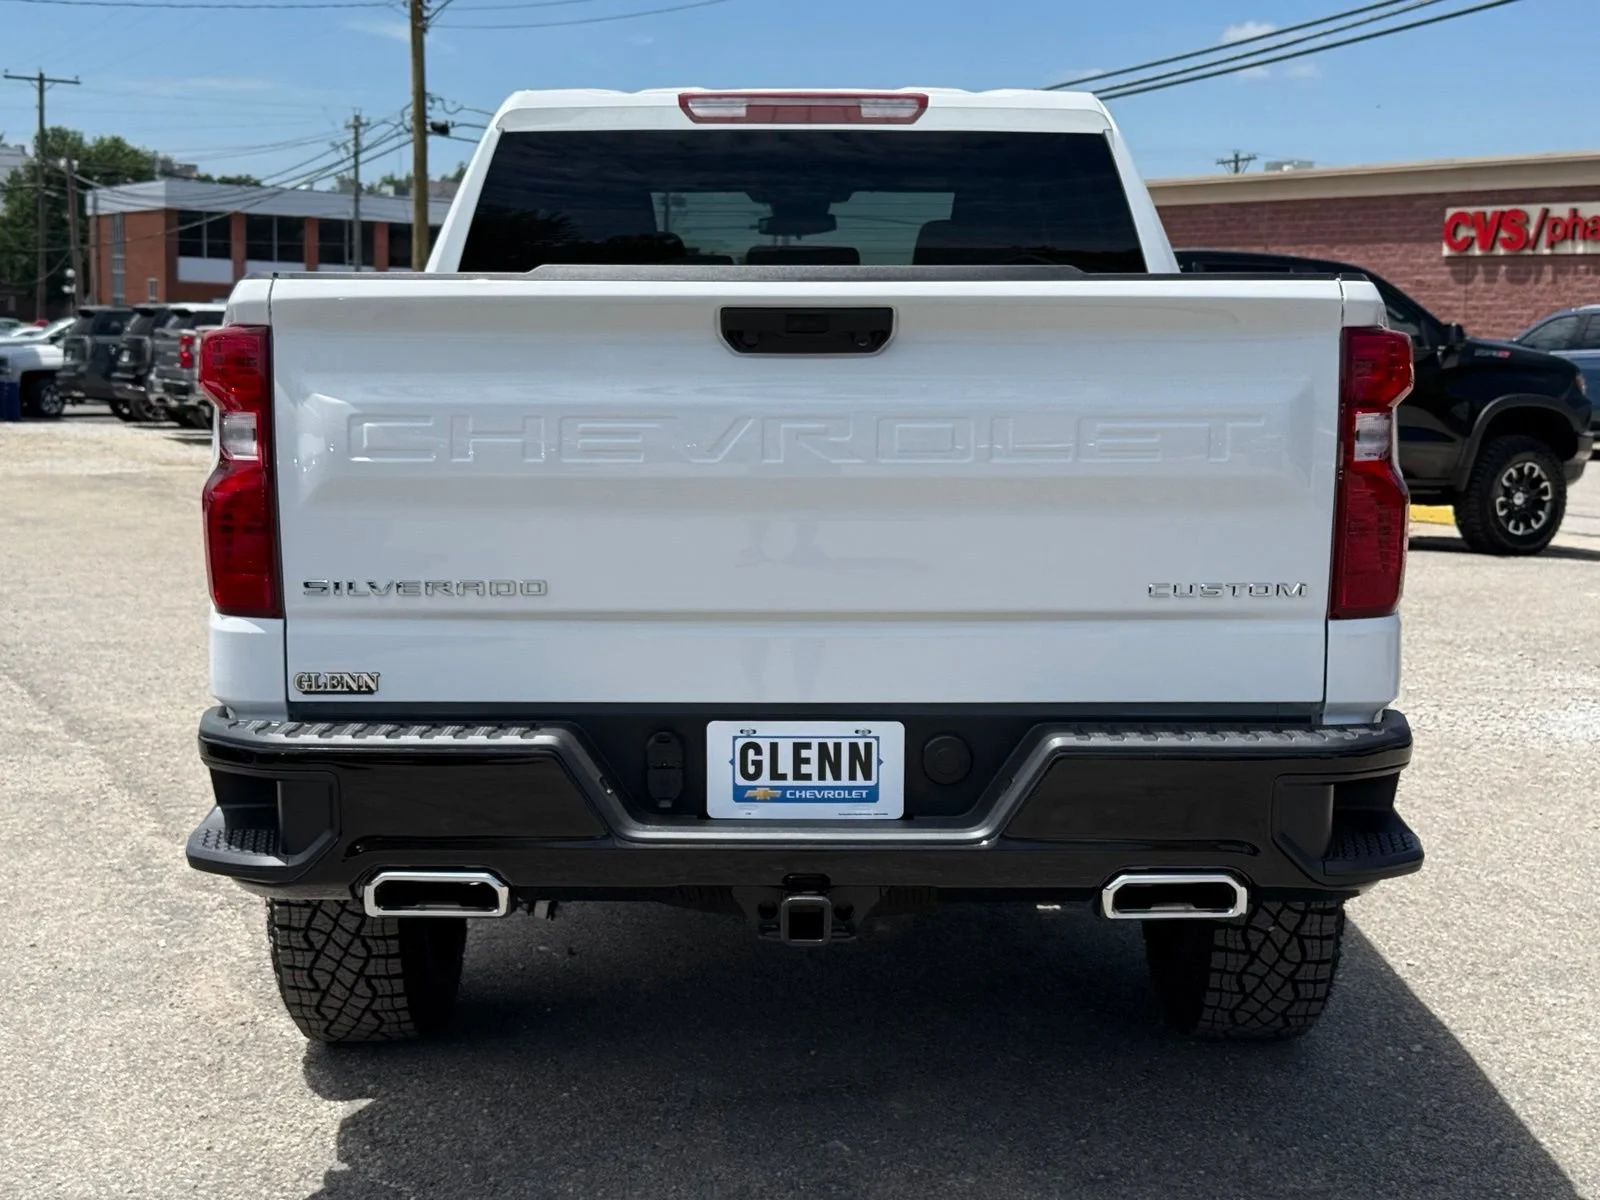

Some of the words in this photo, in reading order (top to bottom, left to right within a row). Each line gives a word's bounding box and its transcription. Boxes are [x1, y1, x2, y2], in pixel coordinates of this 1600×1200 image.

[347, 414, 1265, 464] CHEVROLET
[303, 579, 548, 597] SILVERADO
[1148, 582, 1308, 598] CUSTOM
[294, 671, 380, 693] GLENN
[739, 741, 873, 781] GLENN
[786, 790, 869, 799] CHEVROLET
